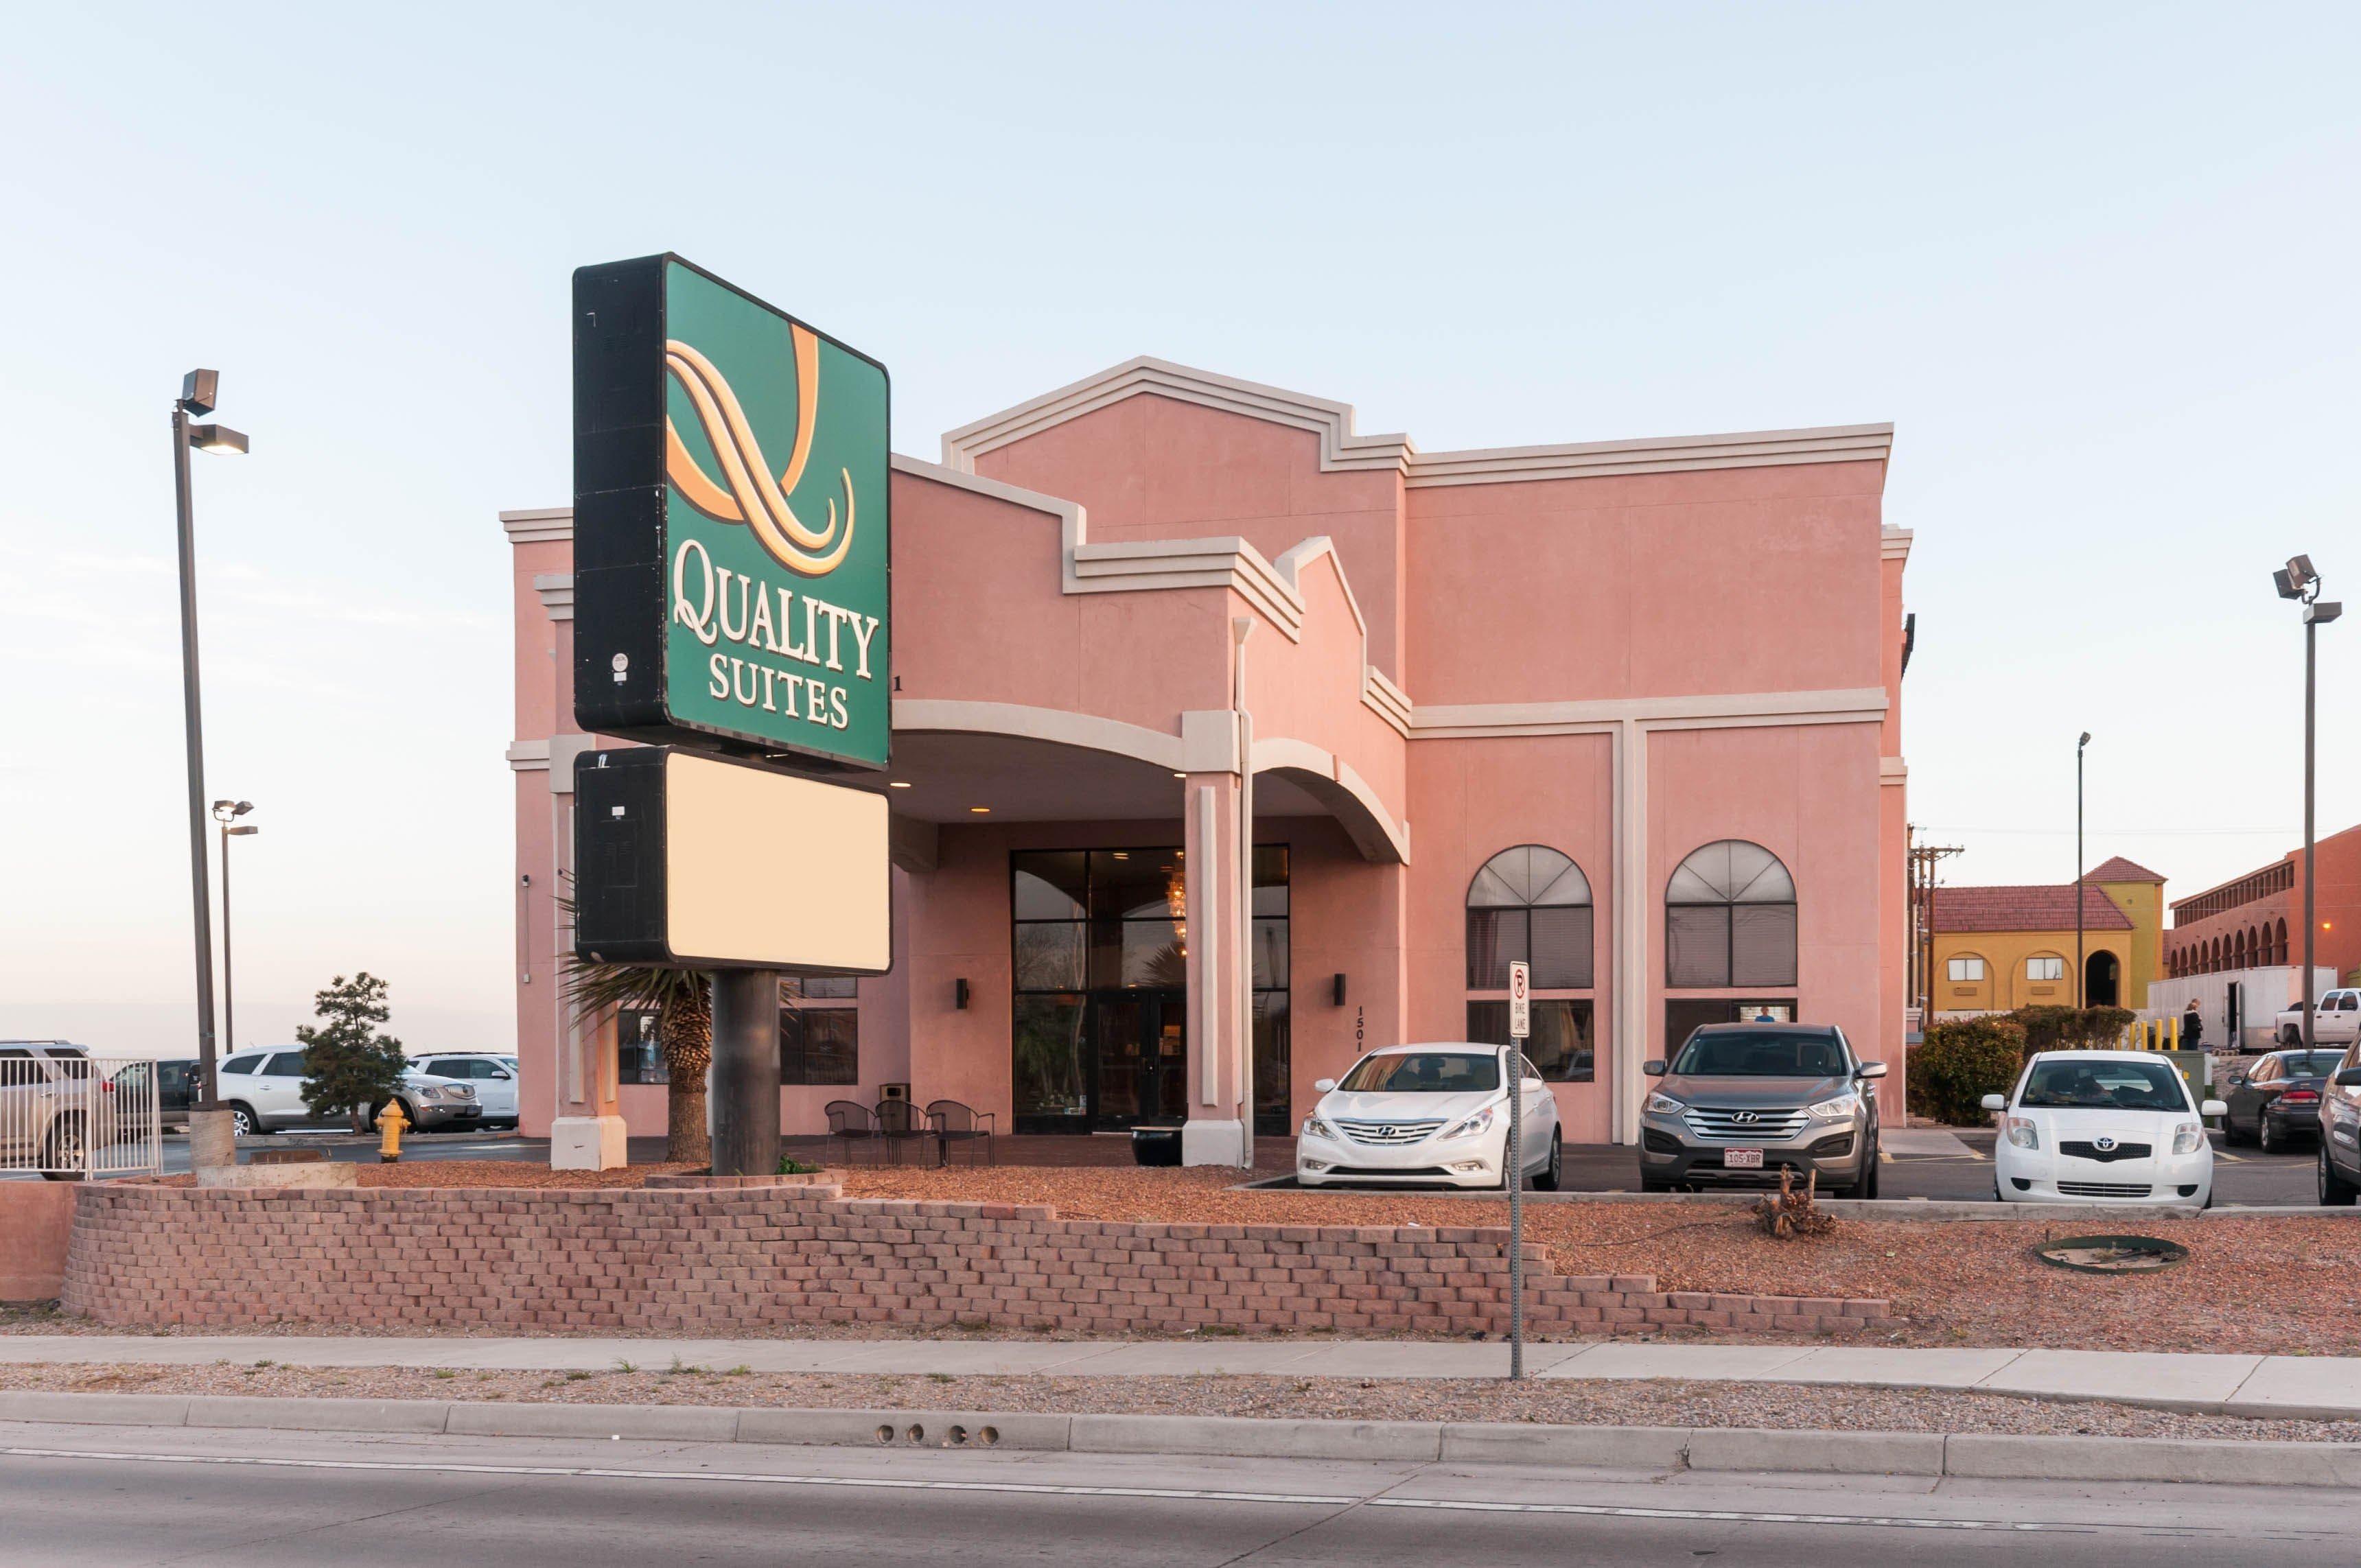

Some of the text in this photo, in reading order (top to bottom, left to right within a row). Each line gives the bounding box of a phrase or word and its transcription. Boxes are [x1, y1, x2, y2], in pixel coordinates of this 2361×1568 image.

[673, 539, 879, 680] QUALITY
[710, 653, 849, 729] SUITES
[1515, 1002, 1525, 1014] BIKE
[1515, 1018, 1526, 1029] LANE
